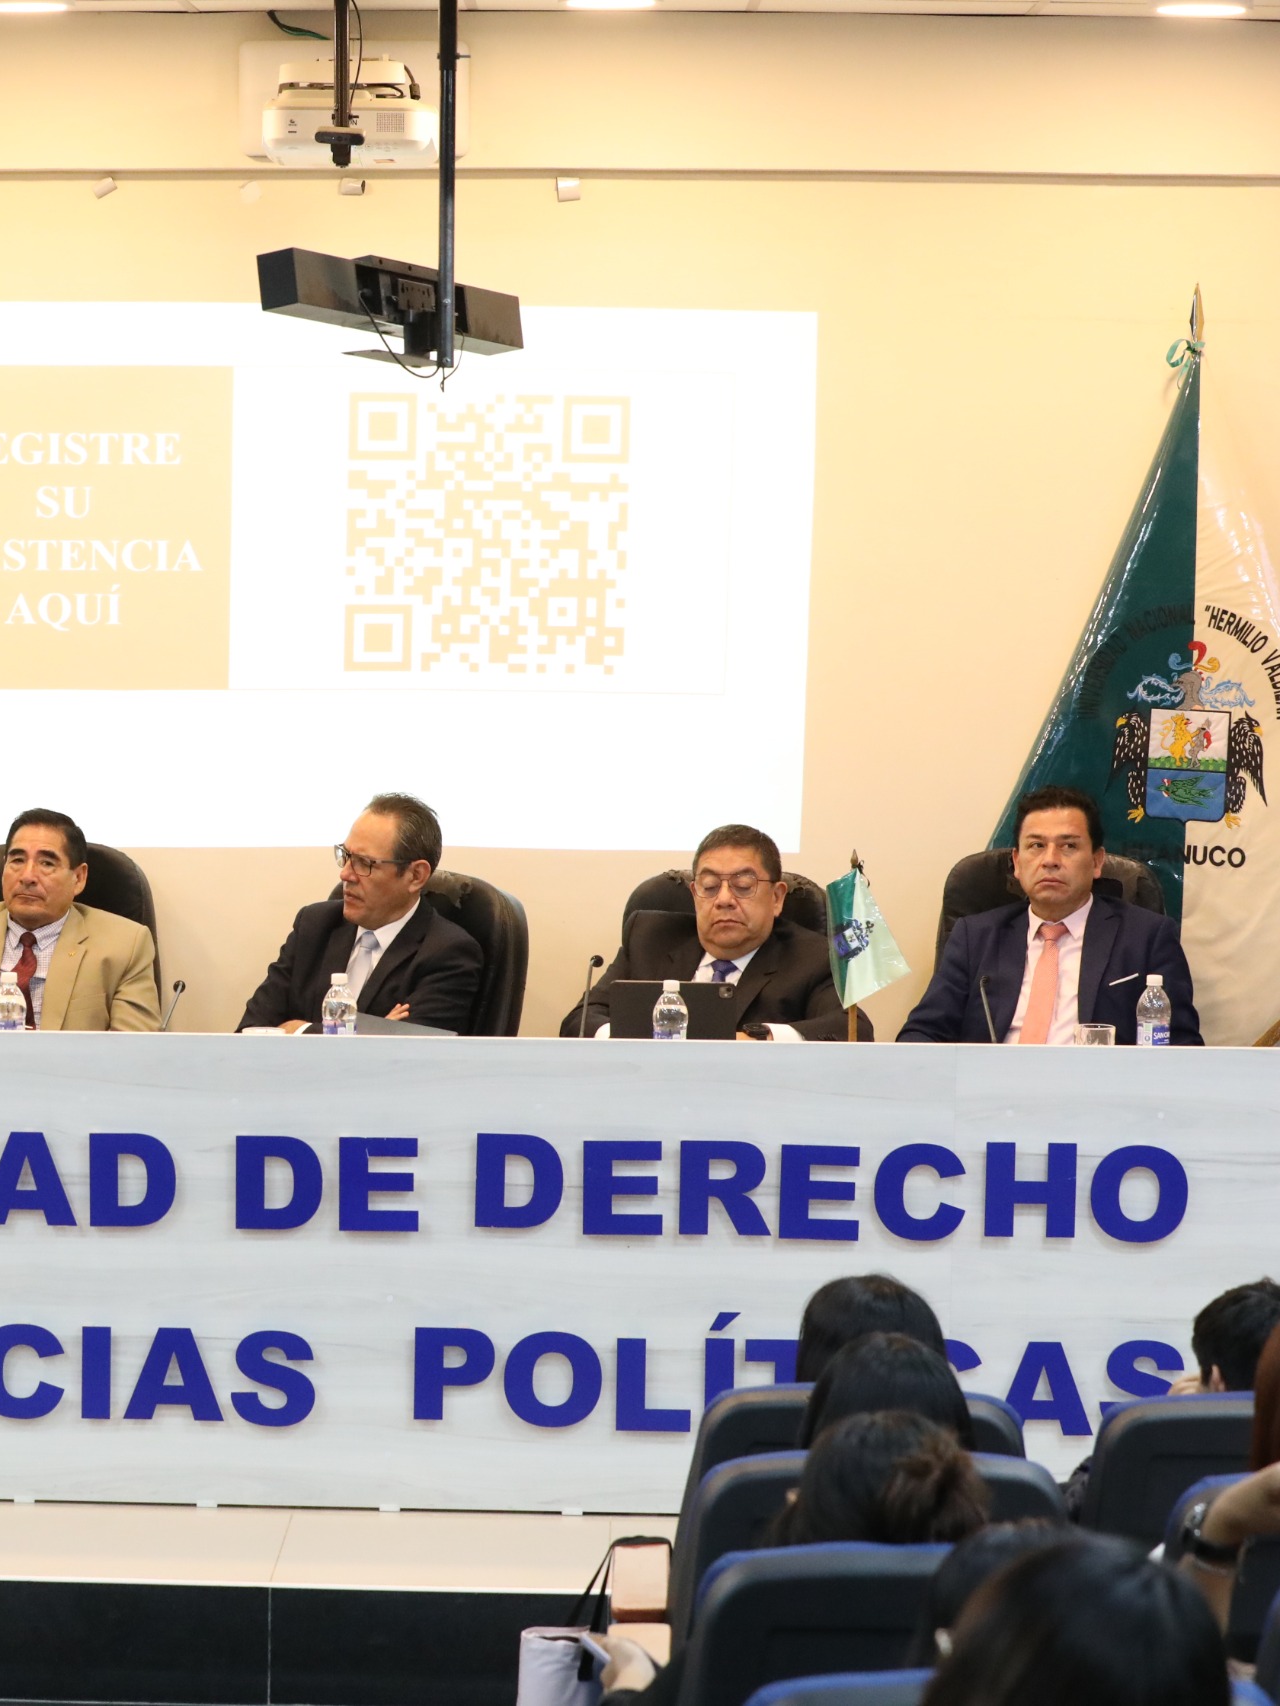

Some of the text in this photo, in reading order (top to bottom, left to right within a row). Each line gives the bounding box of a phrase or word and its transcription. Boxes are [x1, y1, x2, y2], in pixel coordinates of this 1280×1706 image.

[35, 484, 94, 519] SU
[4, 583, 124, 632] AQUÍ
[235, 1135, 420, 1233] DE
[474, 1132, 1189, 1244] DERECHO
[413, 1311, 1186, 1437] POLÍAS
